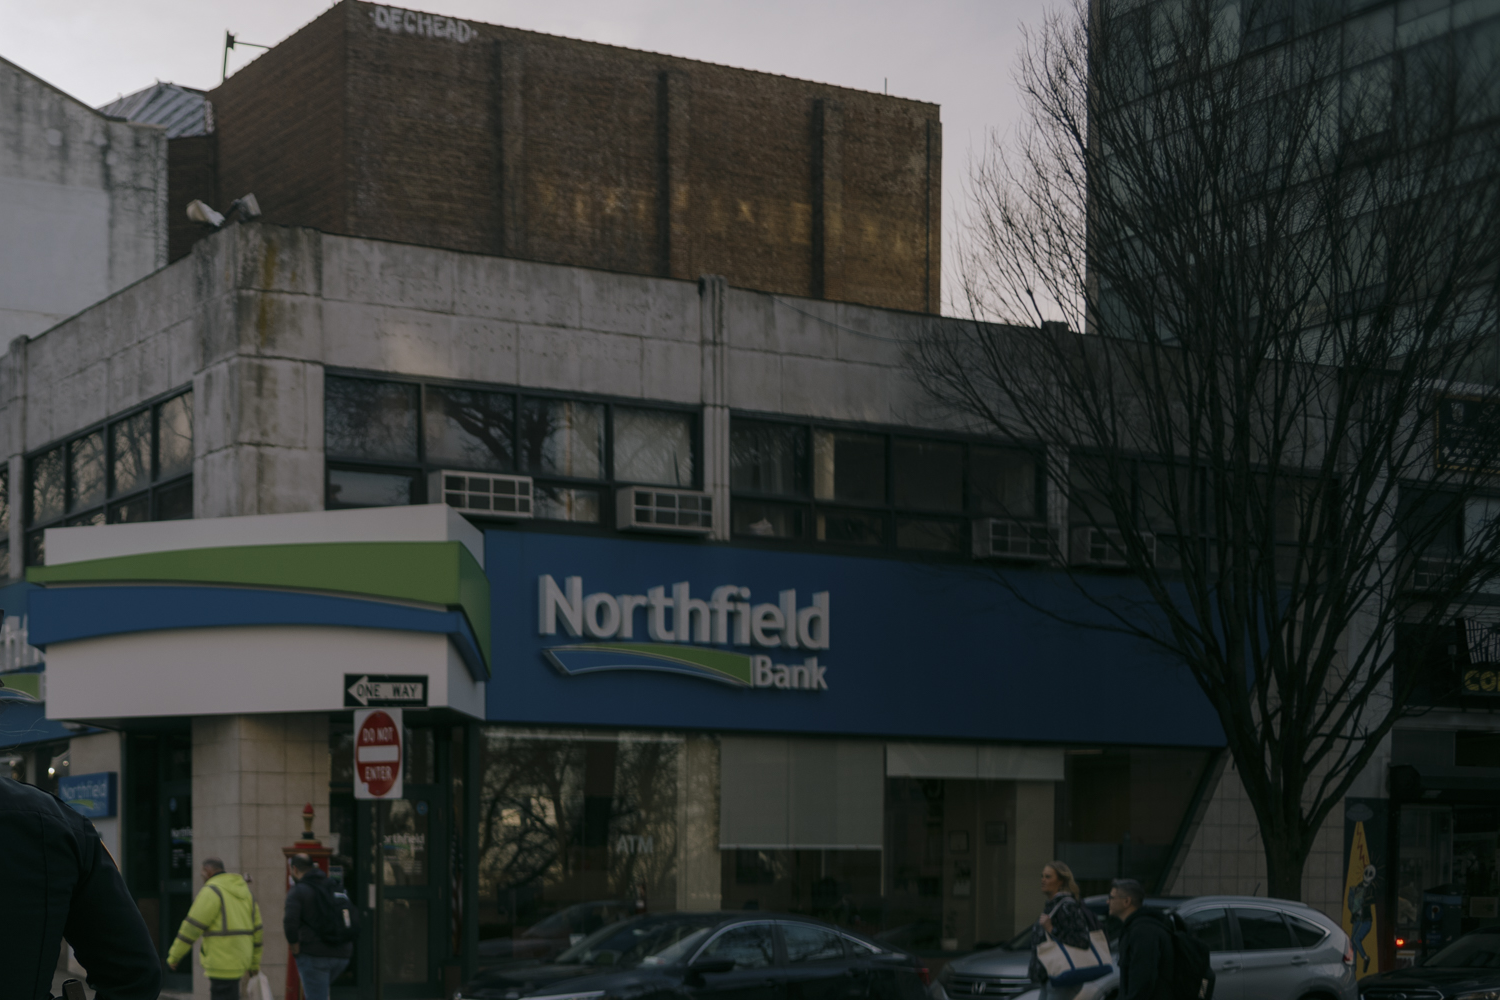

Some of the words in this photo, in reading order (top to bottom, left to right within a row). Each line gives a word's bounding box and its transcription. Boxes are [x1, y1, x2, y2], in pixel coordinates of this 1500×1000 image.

[538, 574, 830, 650] Northfield
[751, 654, 829, 690] Bank
[356, 684, 381, 698] ONE
[392, 684, 418, 698] WAY
[362, 727, 376, 743] DO
[376, 726, 394, 742] NOT
[364, 765, 393, 781] ENTER
[61, 780, 108, 799] Northfield
[616, 834, 654, 853] ATM
